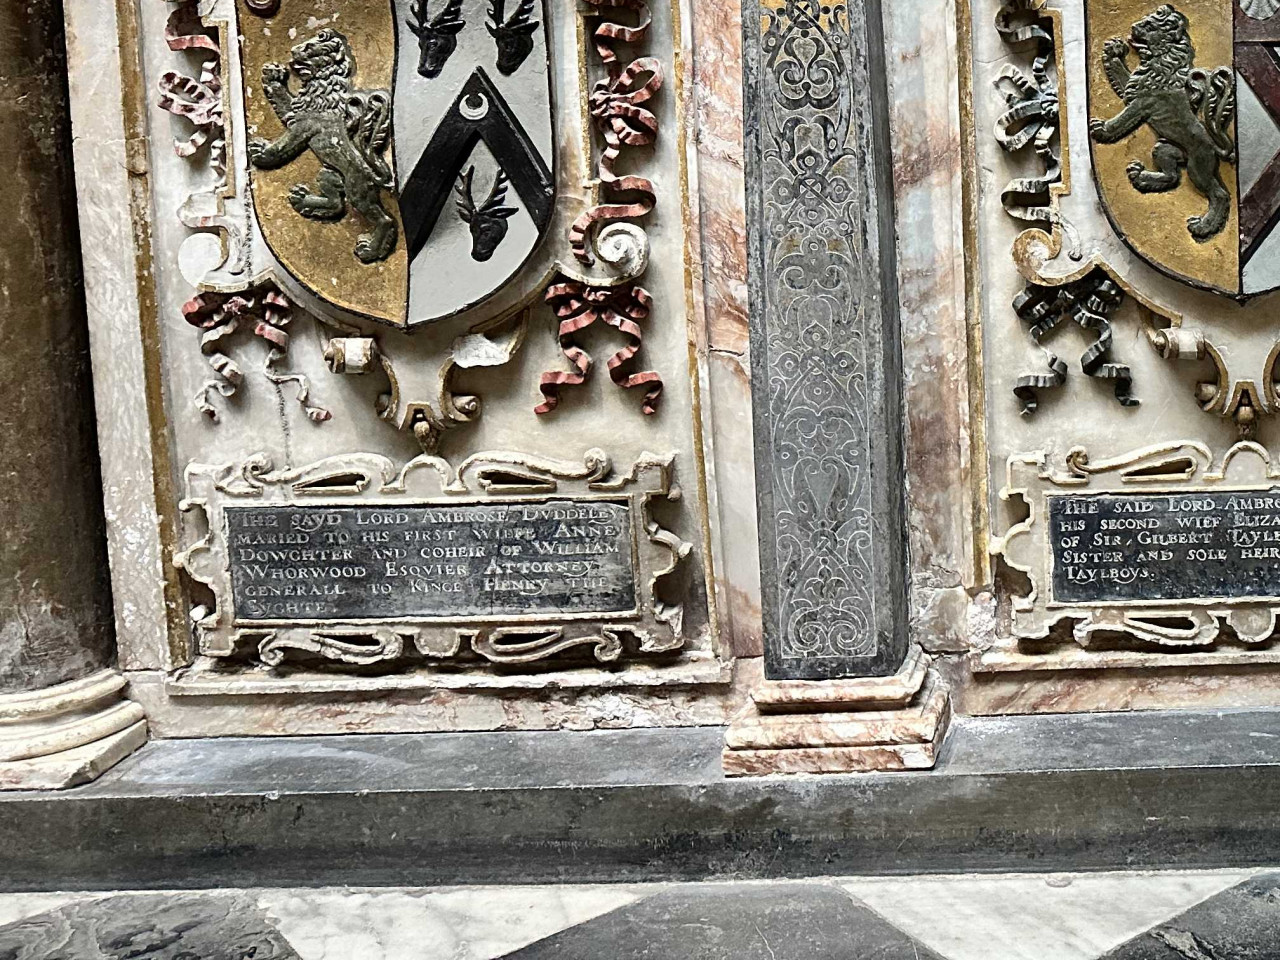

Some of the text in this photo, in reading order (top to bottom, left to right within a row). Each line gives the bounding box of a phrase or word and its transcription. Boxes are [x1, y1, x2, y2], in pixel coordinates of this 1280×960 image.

[1060, 498, 1100, 515] THE
[1113, 500, 1156, 514] SAID
[240, 512, 280, 528] THE
[290, 512, 342, 532] SAYD
[356, 509, 409, 526] LORD
[422, 509, 509, 525] AMBROSE
[1059, 519, 1087, 533] HIS
[1099, 517, 1162, 531] SECOND
[236, 521, 618, 546] MARIED TO HIS FIRST ANNE
[1060, 535, 1082, 550] OF
[1092, 531, 1123, 547] SIR
[1136, 530, 1213, 546] GILBERT
[371, 546, 407, 560] AND
[419, 544, 487, 559] COHEIR
[500, 543, 522, 557] OF
[531, 540, 621, 555] WILLIAM
[1061, 549, 1125, 565] SISTER
[1136, 549, 1174, 563] AND
[1185, 548, 1228, 562] SOLE
[240, 554, 600, 582] WHORWOOD ESQVIER ATTORNEY
[244, 582, 347, 597] GENERALL
[371, 581, 393, 595] TO
[483, 575, 550, 596] HENRY
